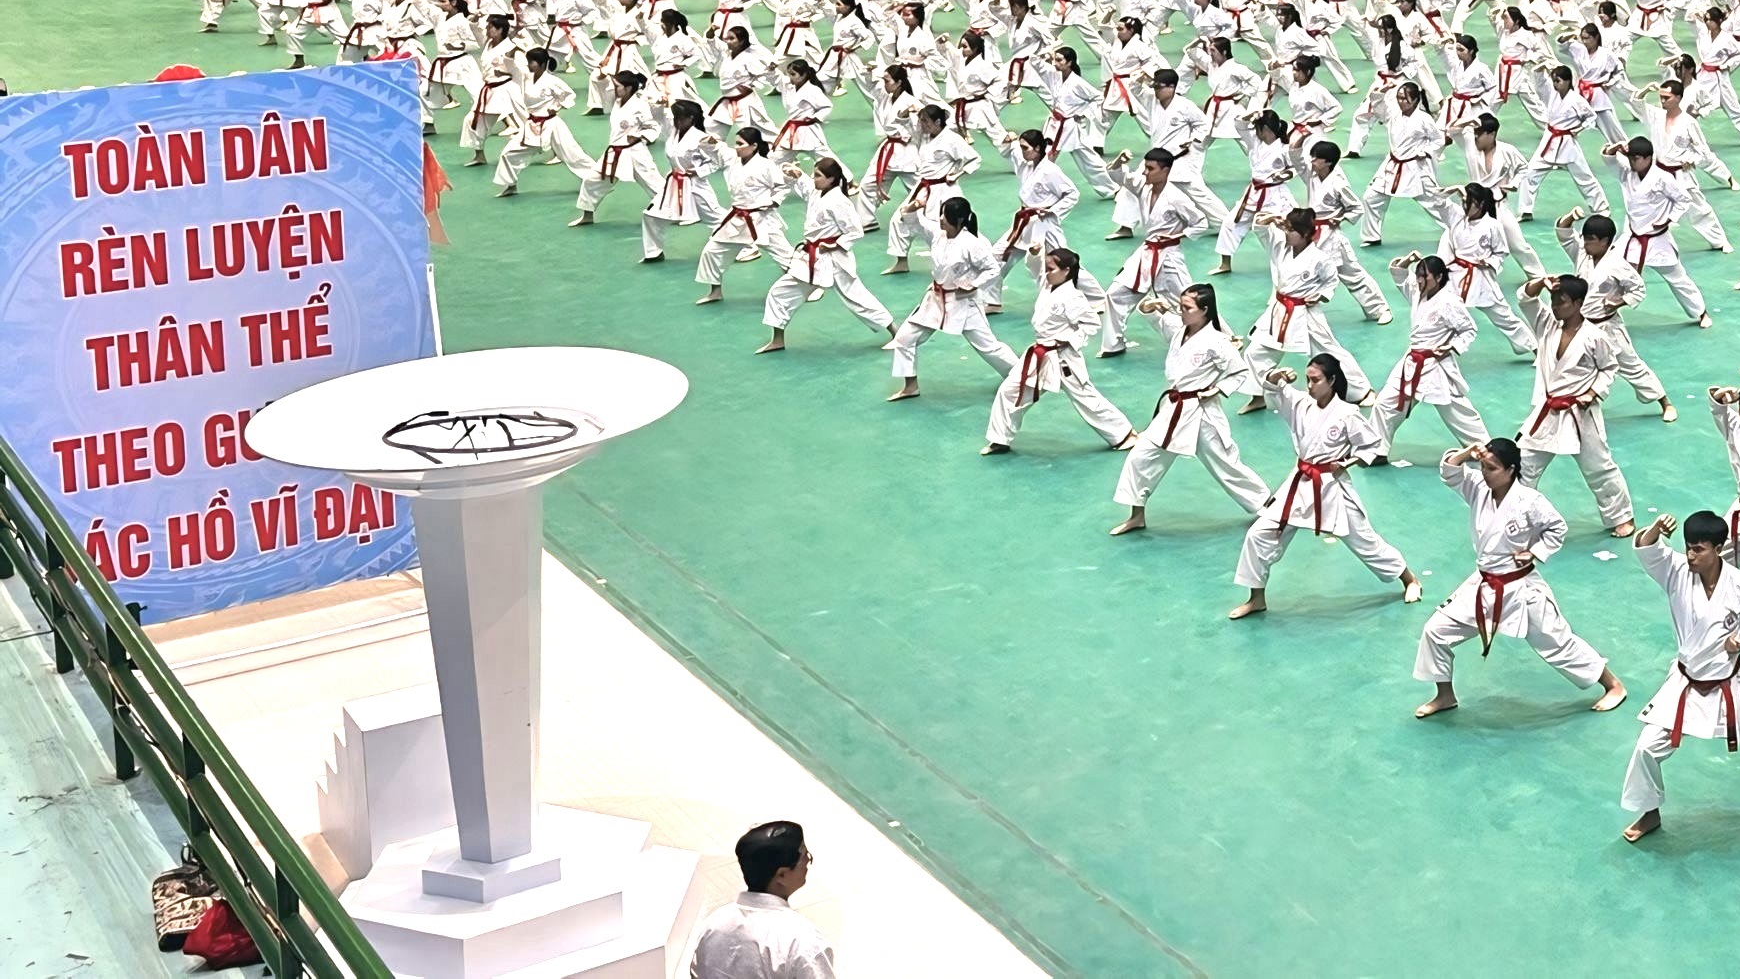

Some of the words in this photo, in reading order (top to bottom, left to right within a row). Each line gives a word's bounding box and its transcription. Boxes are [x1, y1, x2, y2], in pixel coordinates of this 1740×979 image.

[63, 124, 206, 199] TOÀN
[222, 111, 328, 181] DÂN
[60, 226, 169, 298] RÈN
[185, 204, 344, 280] LUYỆN
[85, 315, 225, 391] THÂN
[240, 282, 333, 367] THỂ
[53, 421, 186, 493] THEO
[65, 518, 151, 584] ÁC
[168, 488, 238, 570] HỒ
[250, 484, 300, 552] VĨ
[313, 483, 396, 543] ĐẠI
